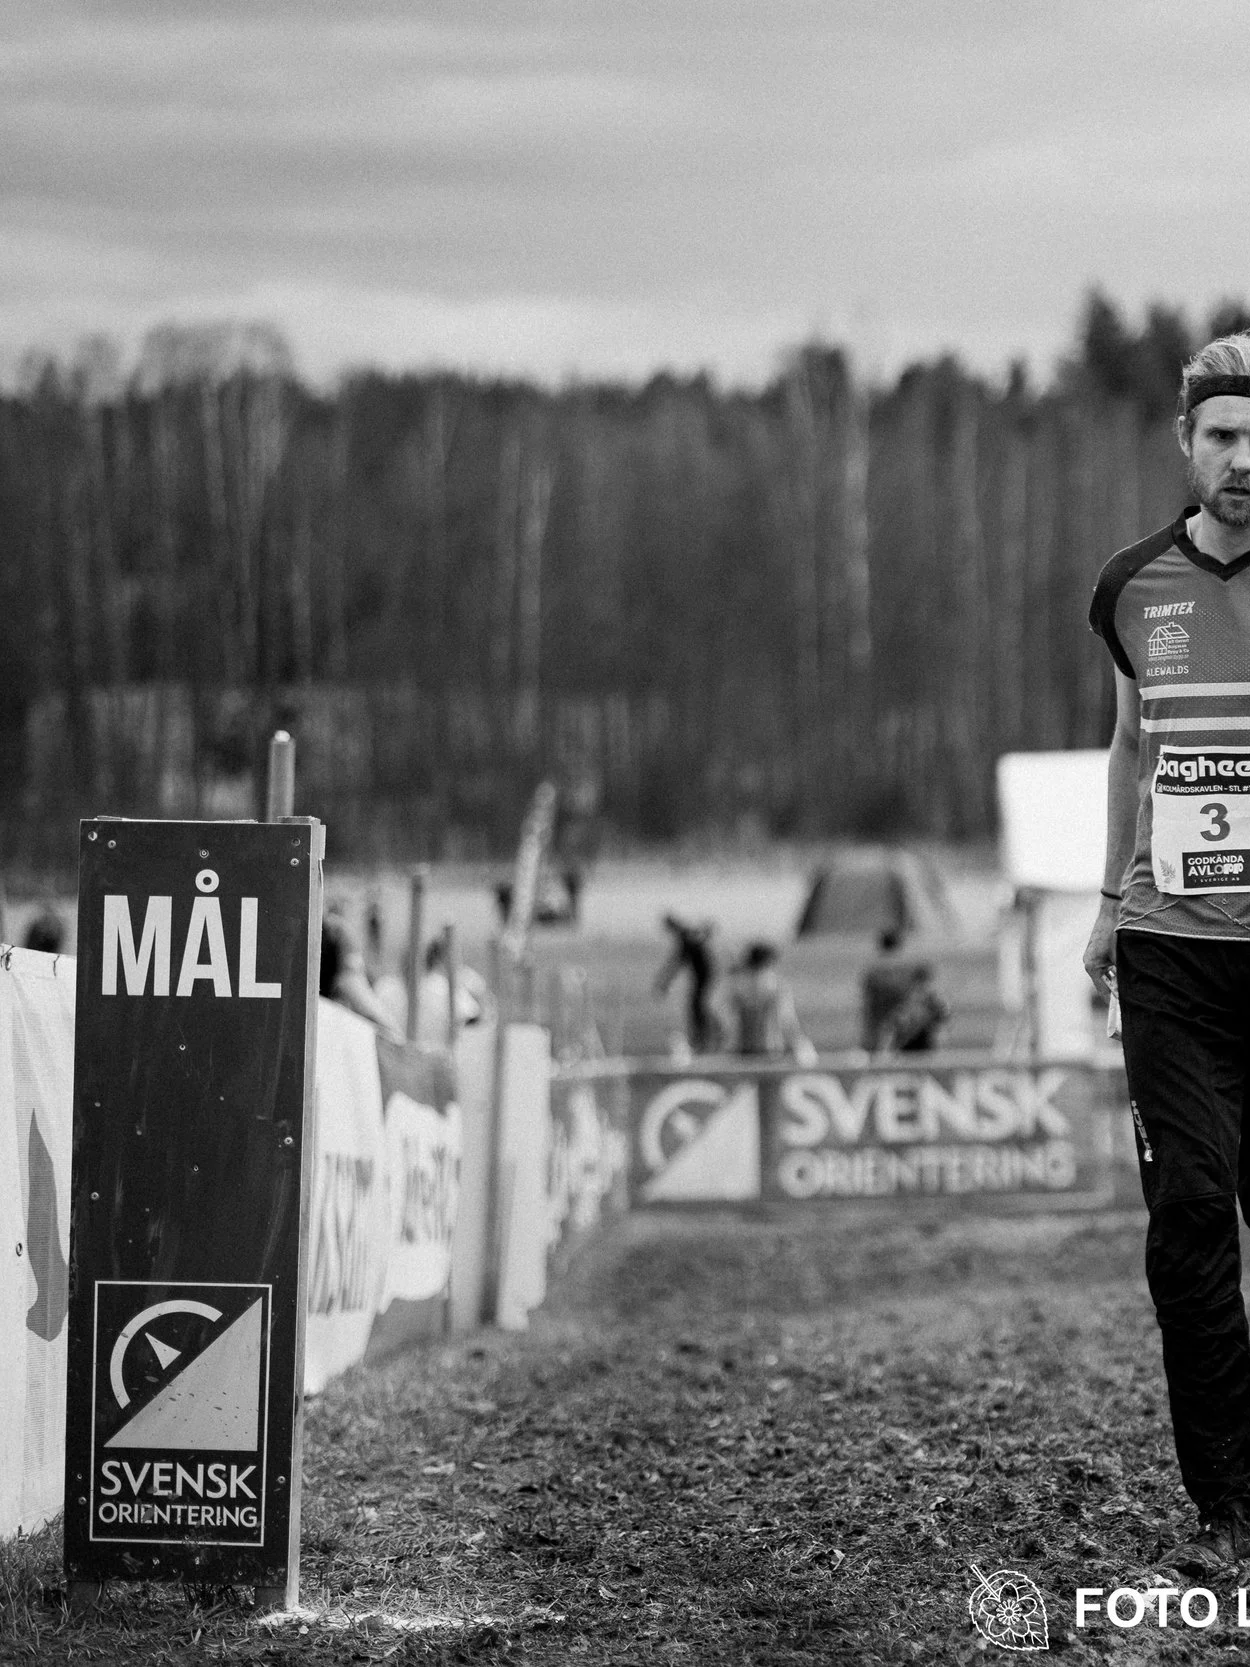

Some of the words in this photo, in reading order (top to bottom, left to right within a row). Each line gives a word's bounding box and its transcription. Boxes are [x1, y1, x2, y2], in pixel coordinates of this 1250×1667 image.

[1143, 601, 1196, 619] TRIMTEX
[1146, 665, 1189, 677] ALEWALDS
[1199, 802, 1231, 842] 3
[1187, 853, 1245, 866] GODKÄNDA
[102, 868, 282, 999] MÅL
[779, 1069, 1071, 1146] SVENSK
[777, 1140, 1077, 1198] ORIENTERING
[100, 1460, 257, 1499] SVENSK
[98, 1502, 258, 1528] ORIENTERING
